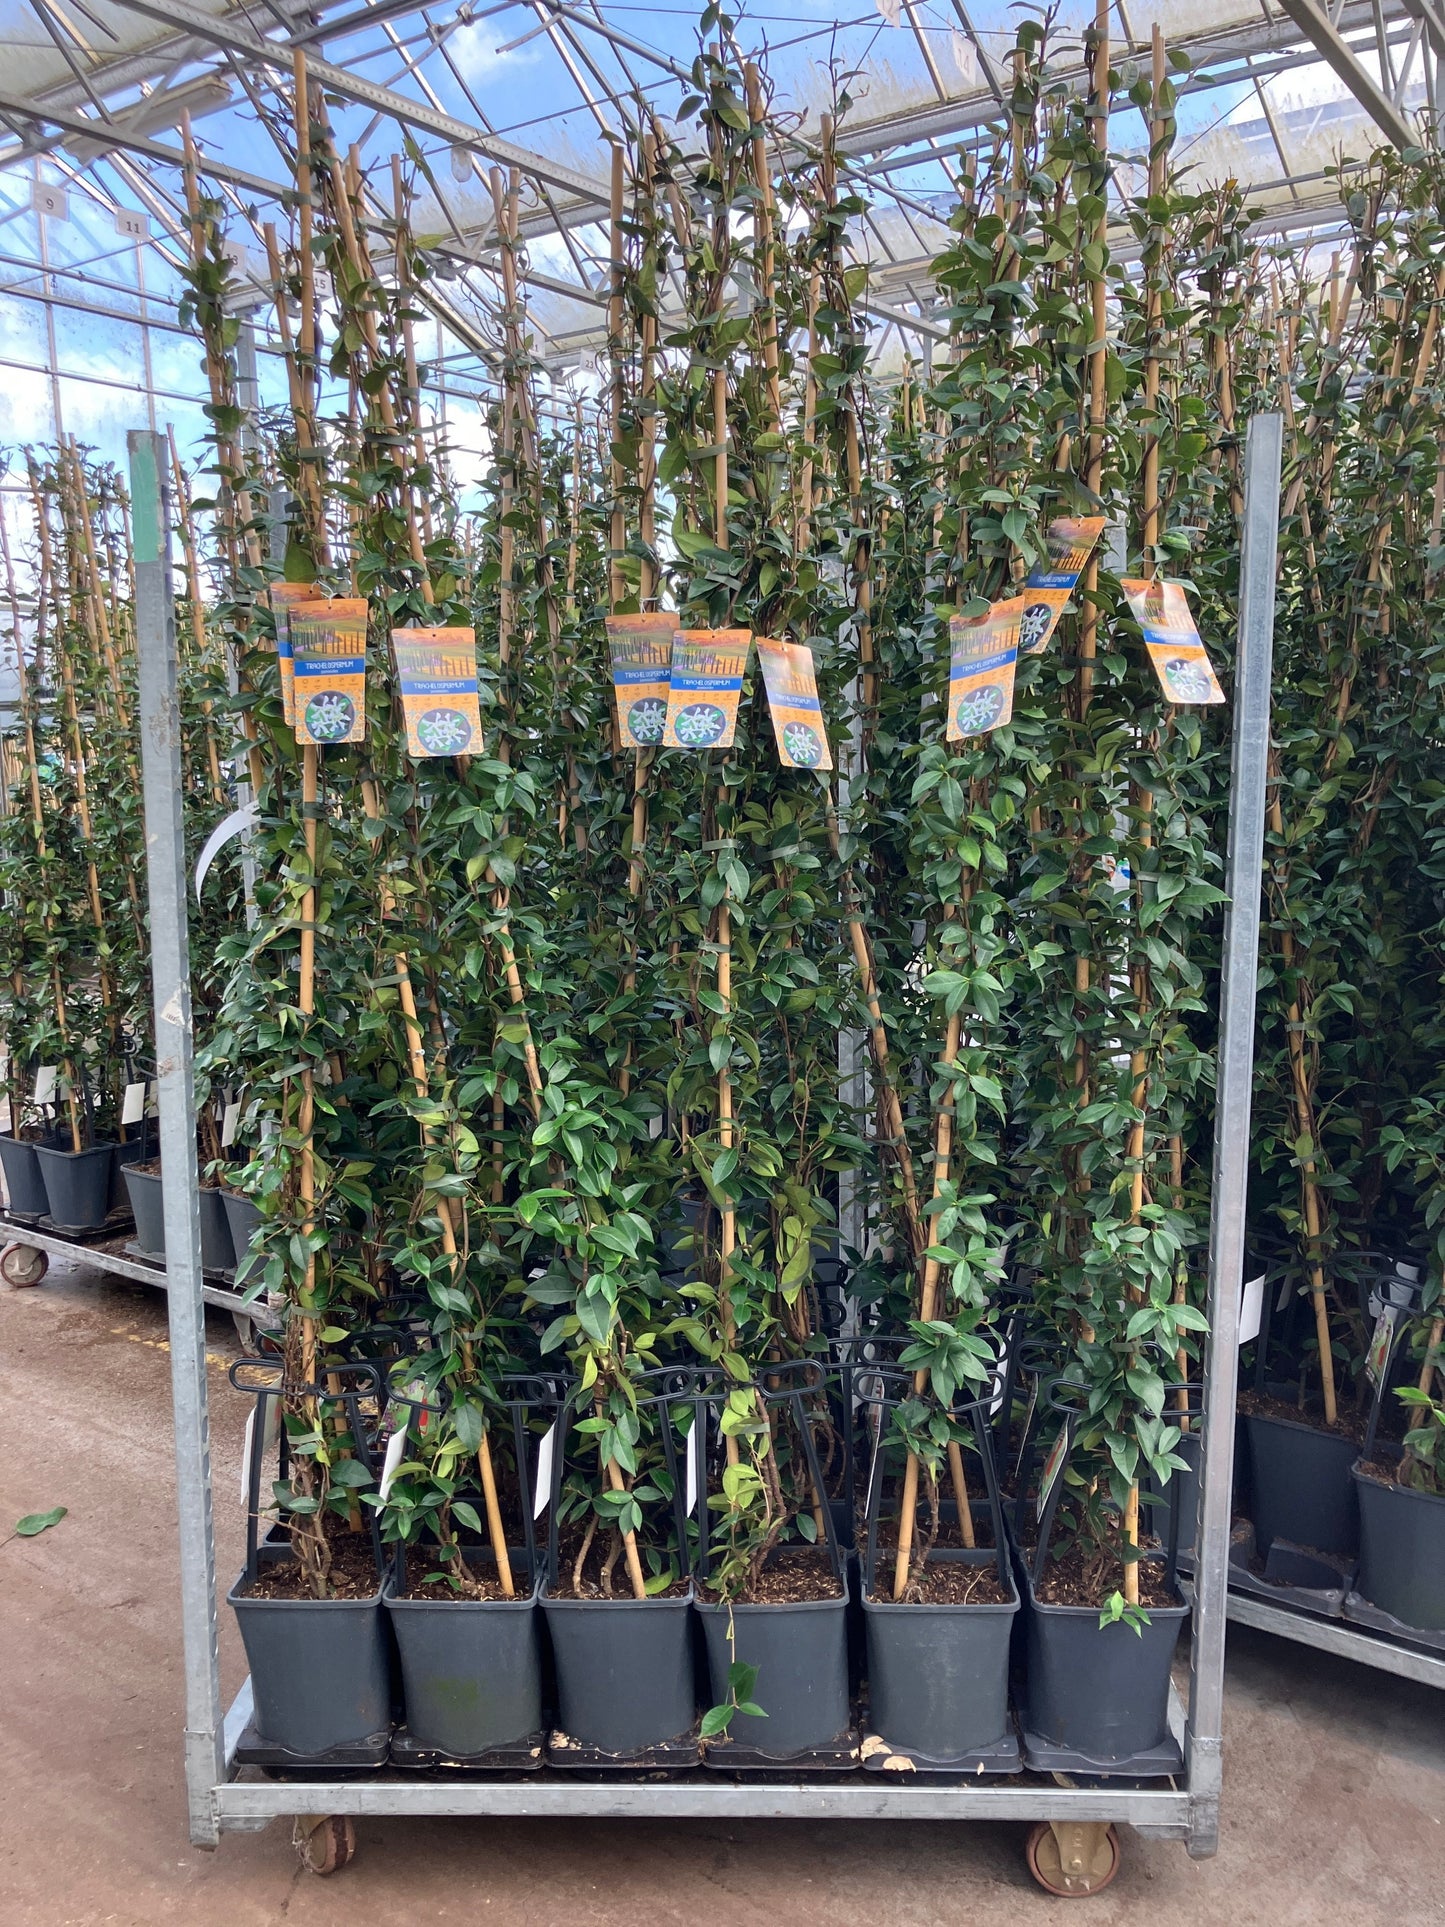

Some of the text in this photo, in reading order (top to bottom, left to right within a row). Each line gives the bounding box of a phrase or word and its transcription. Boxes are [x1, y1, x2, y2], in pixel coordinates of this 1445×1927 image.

[46, 198, 54, 210] 9
[126, 221, 140, 234] 11
[315, 278, 326, 289] 15
[585, 359, 594, 370] 23
[305, 660, 354, 670] TRACHELOSPERMUM
[624, 669, 671, 679] TRACHELOSPERMUM
[682, 679, 731, 687] TRACHELOSPERMUM
